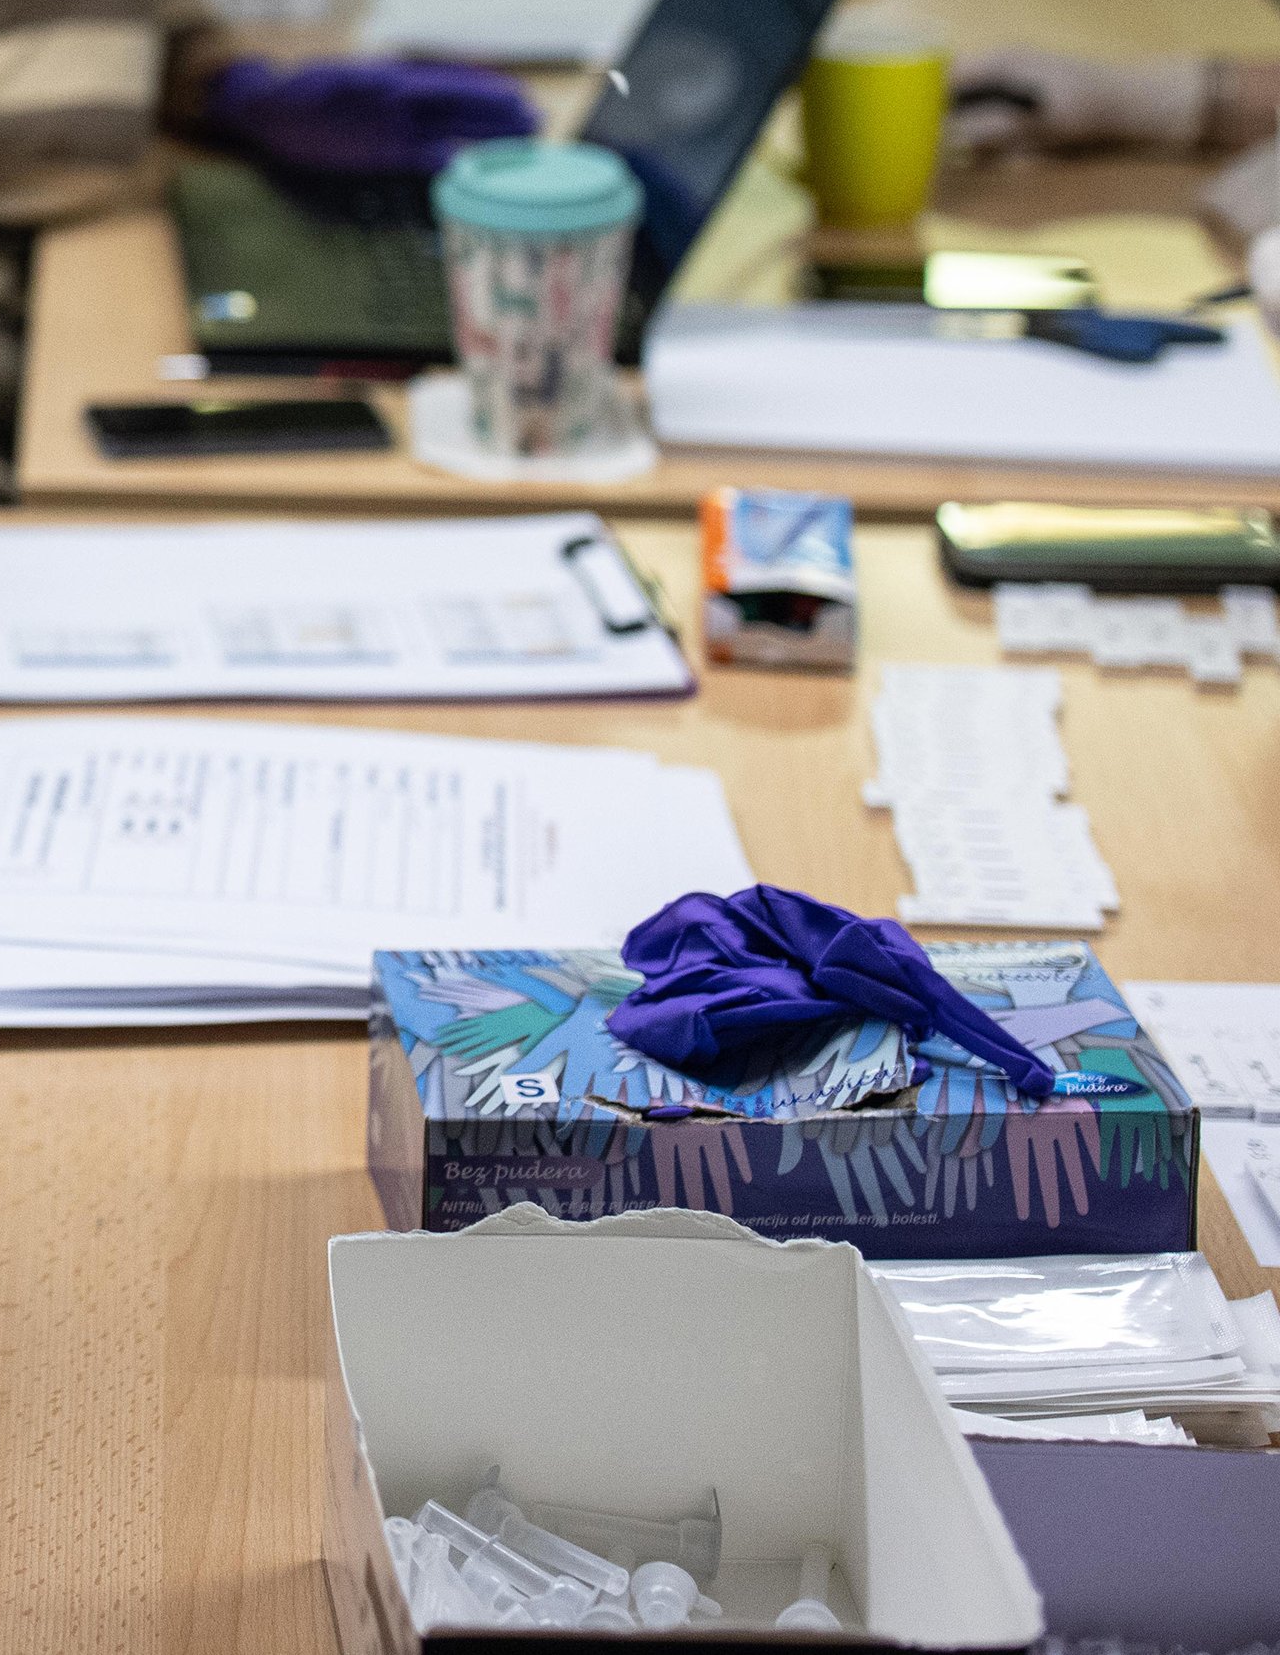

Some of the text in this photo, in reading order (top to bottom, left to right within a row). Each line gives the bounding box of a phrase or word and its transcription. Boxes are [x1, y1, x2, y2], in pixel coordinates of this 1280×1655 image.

[516, 1078, 546, 1098] S
[1065, 1082, 1129, 1097] pudera
[443, 1159, 591, 1186] Bez pudera
